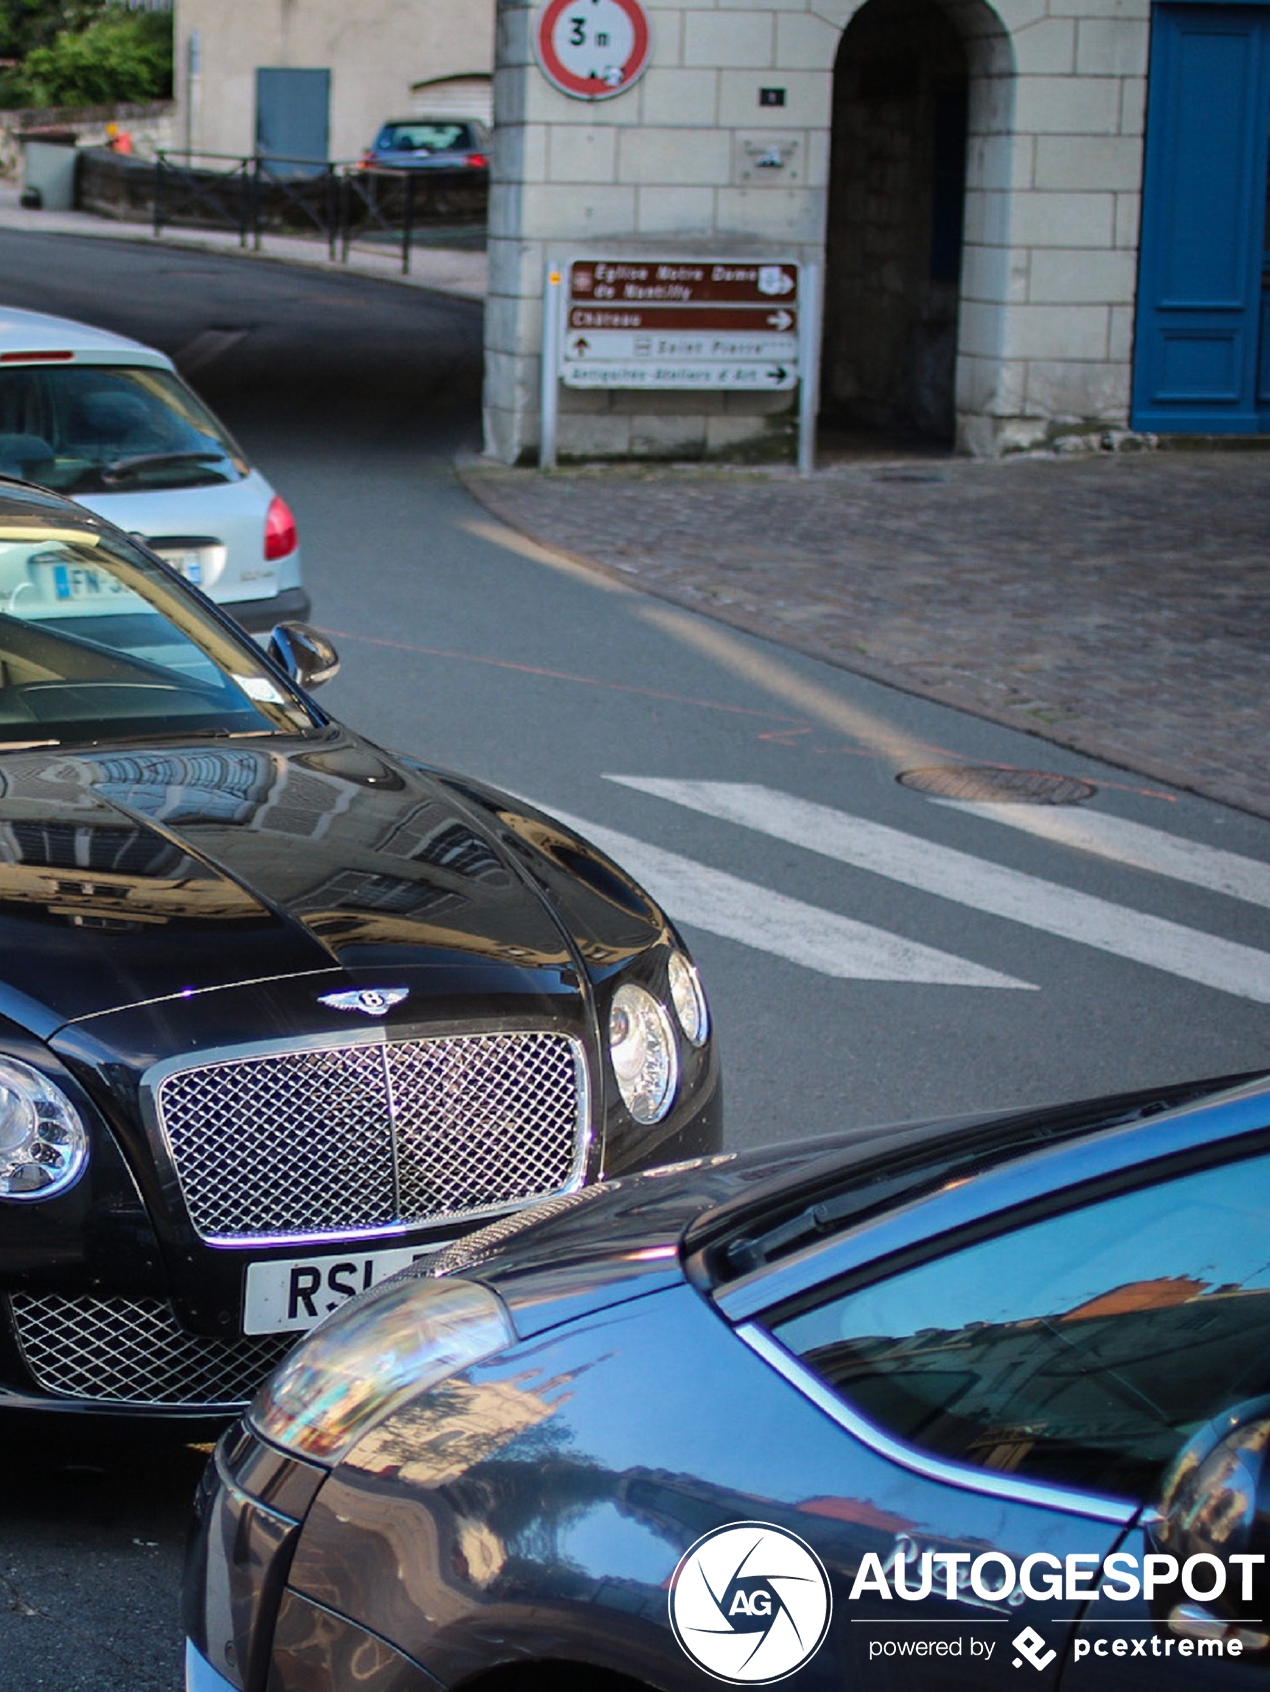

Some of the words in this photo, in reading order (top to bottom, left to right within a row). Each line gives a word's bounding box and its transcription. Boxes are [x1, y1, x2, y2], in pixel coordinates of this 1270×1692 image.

[570, 17, 585, 47] 3
[597, 32, 608, 47] m
[711, 266, 758, 281] Dame
[594, 283, 615, 299] de
